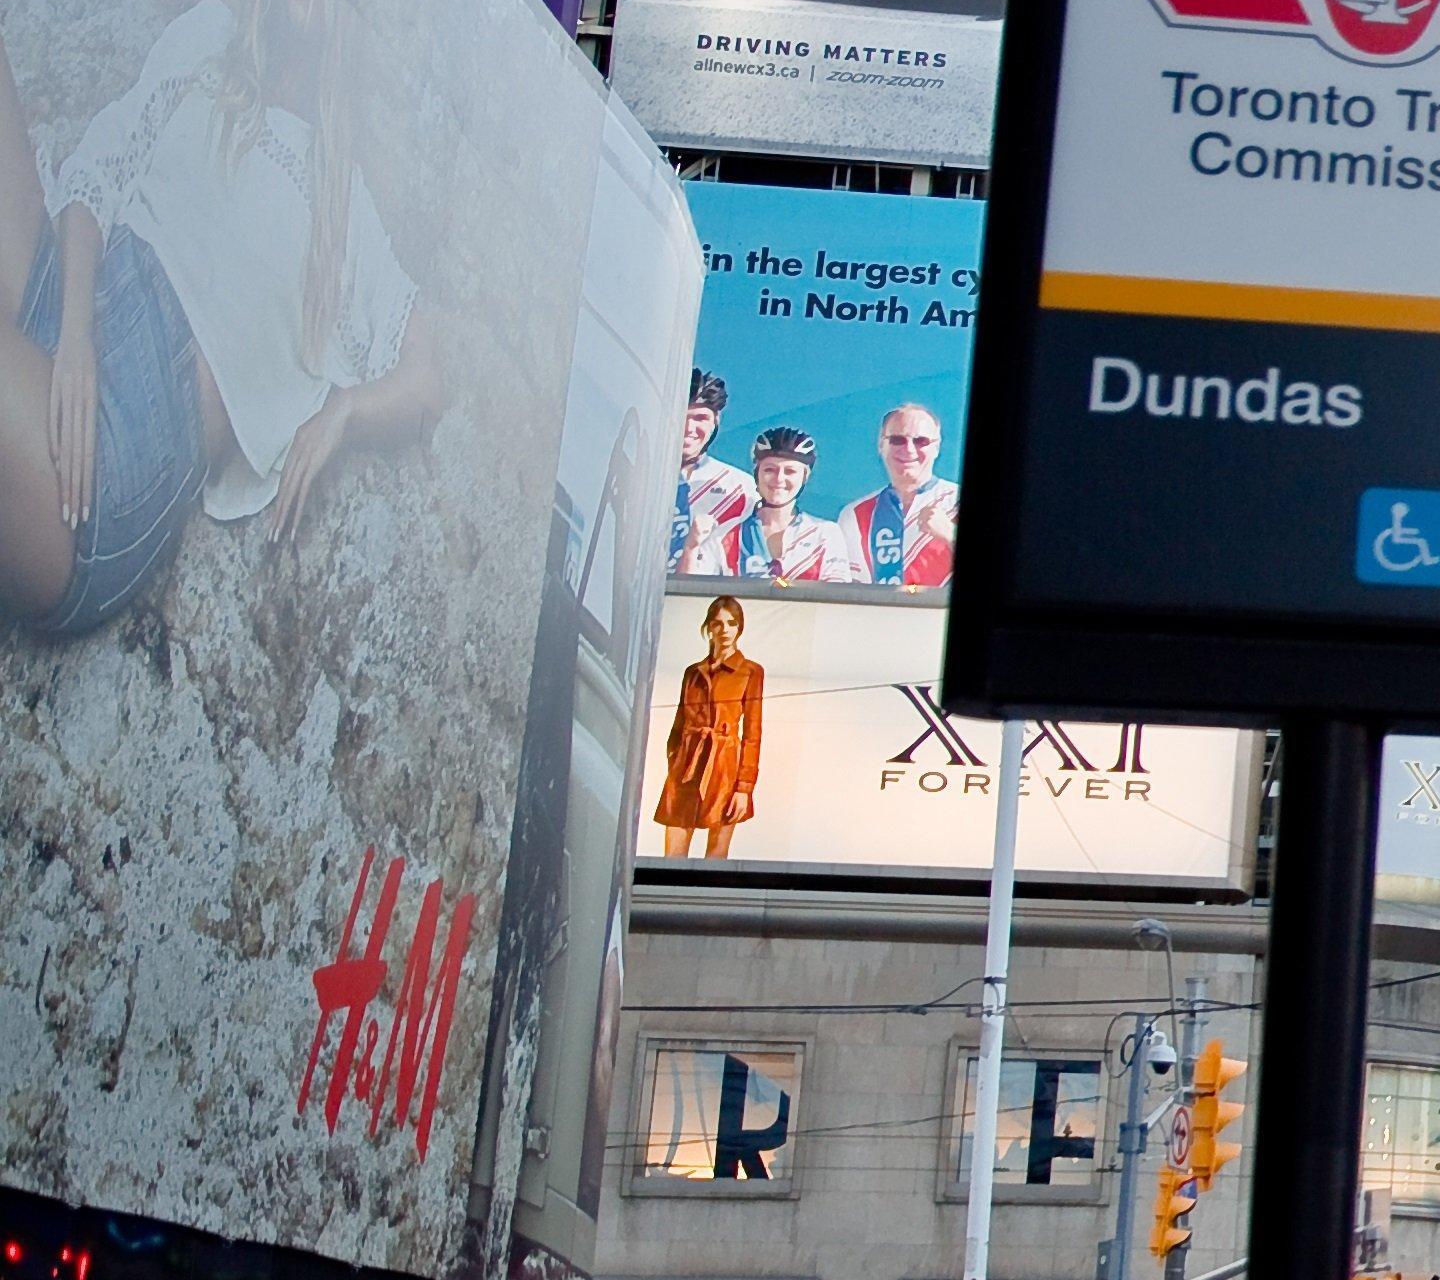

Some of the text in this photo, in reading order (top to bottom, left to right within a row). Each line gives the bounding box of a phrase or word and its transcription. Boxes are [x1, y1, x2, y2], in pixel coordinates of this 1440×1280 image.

[697, 34, 946, 68] DRIVING MATTERS
[694, 58, 944, 89] allnewcx3.ca zoom-zoom
[1162, 71, 1376, 129] Toronto
[746, 248, 941, 290] the largest
[758, 290, 909, 323] in North
[1089, 356, 1362, 428] Dundas
[298, 847, 475, 1163] H&M
